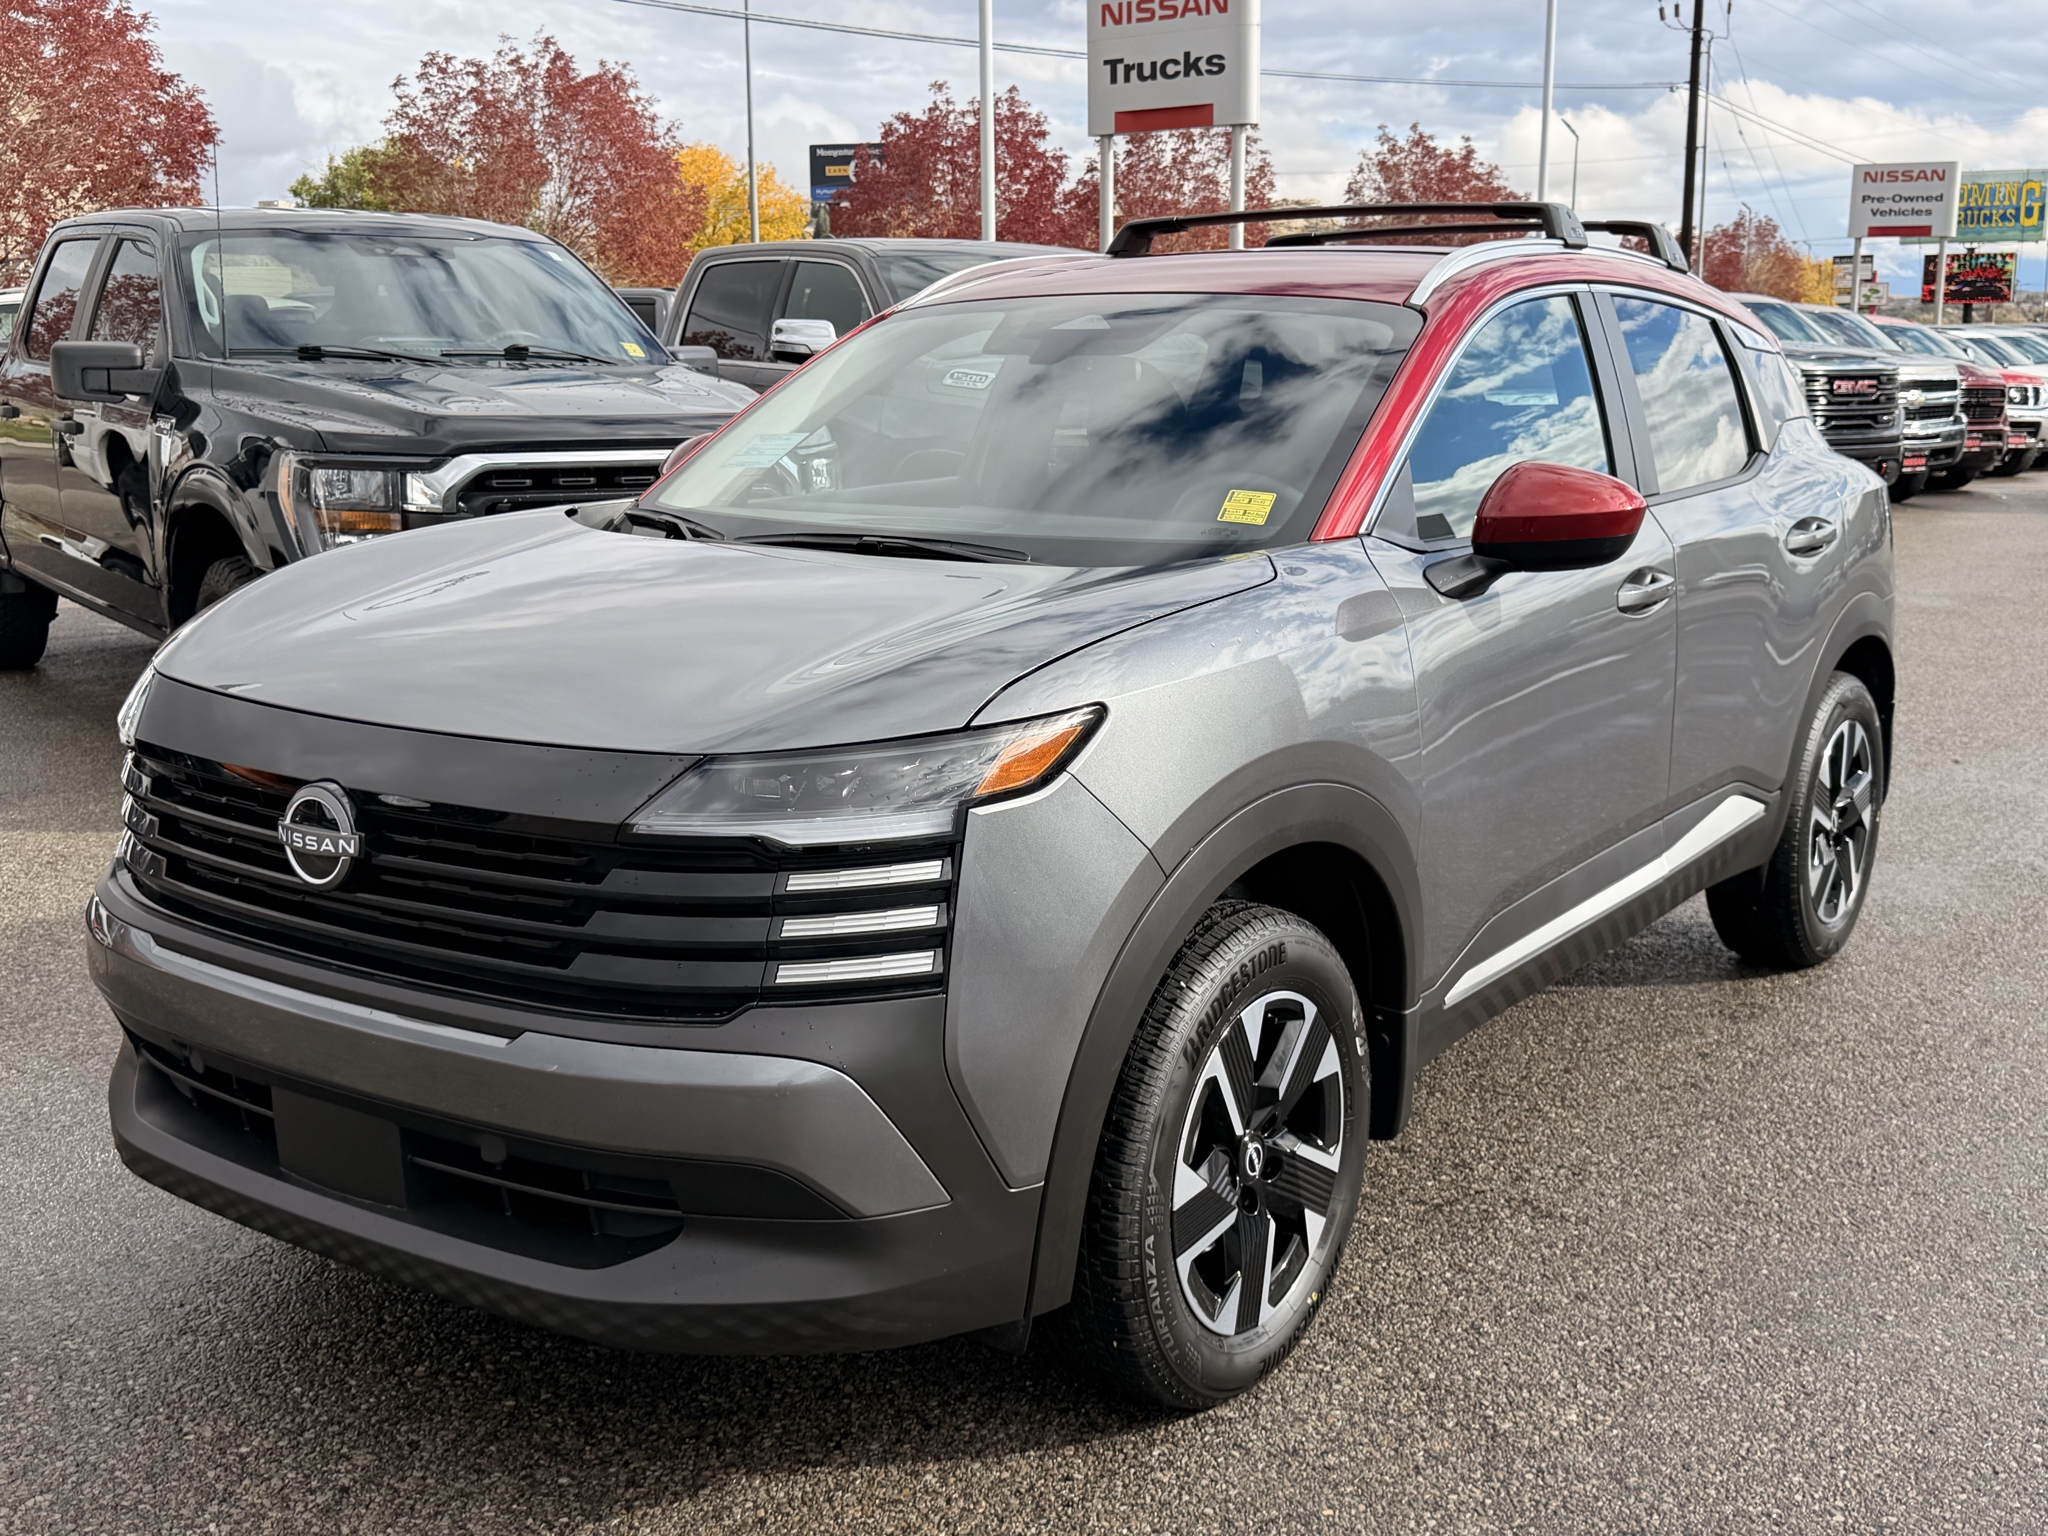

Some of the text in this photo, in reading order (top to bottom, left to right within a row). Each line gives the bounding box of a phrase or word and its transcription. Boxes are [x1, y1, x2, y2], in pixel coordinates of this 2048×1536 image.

[1101, 0, 1229, 27] NISSAN
[1103, 51, 1226, 85] Trucks
[816, 147, 855, 158] Momentu
[1863, 168, 1946, 183] NISSAN
[1861, 192, 1944, 204] Pre-Owned
[1870, 207, 1933, 217] Vehicles
[953, 372, 986, 382] 1500
[1833, 380, 1878, 394] GMC
[278, 825, 355, 854] NISSAN
[1183, 941, 1287, 1072] BRIDGESTONE
[1144, 1234, 1180, 1364] TURANZA
